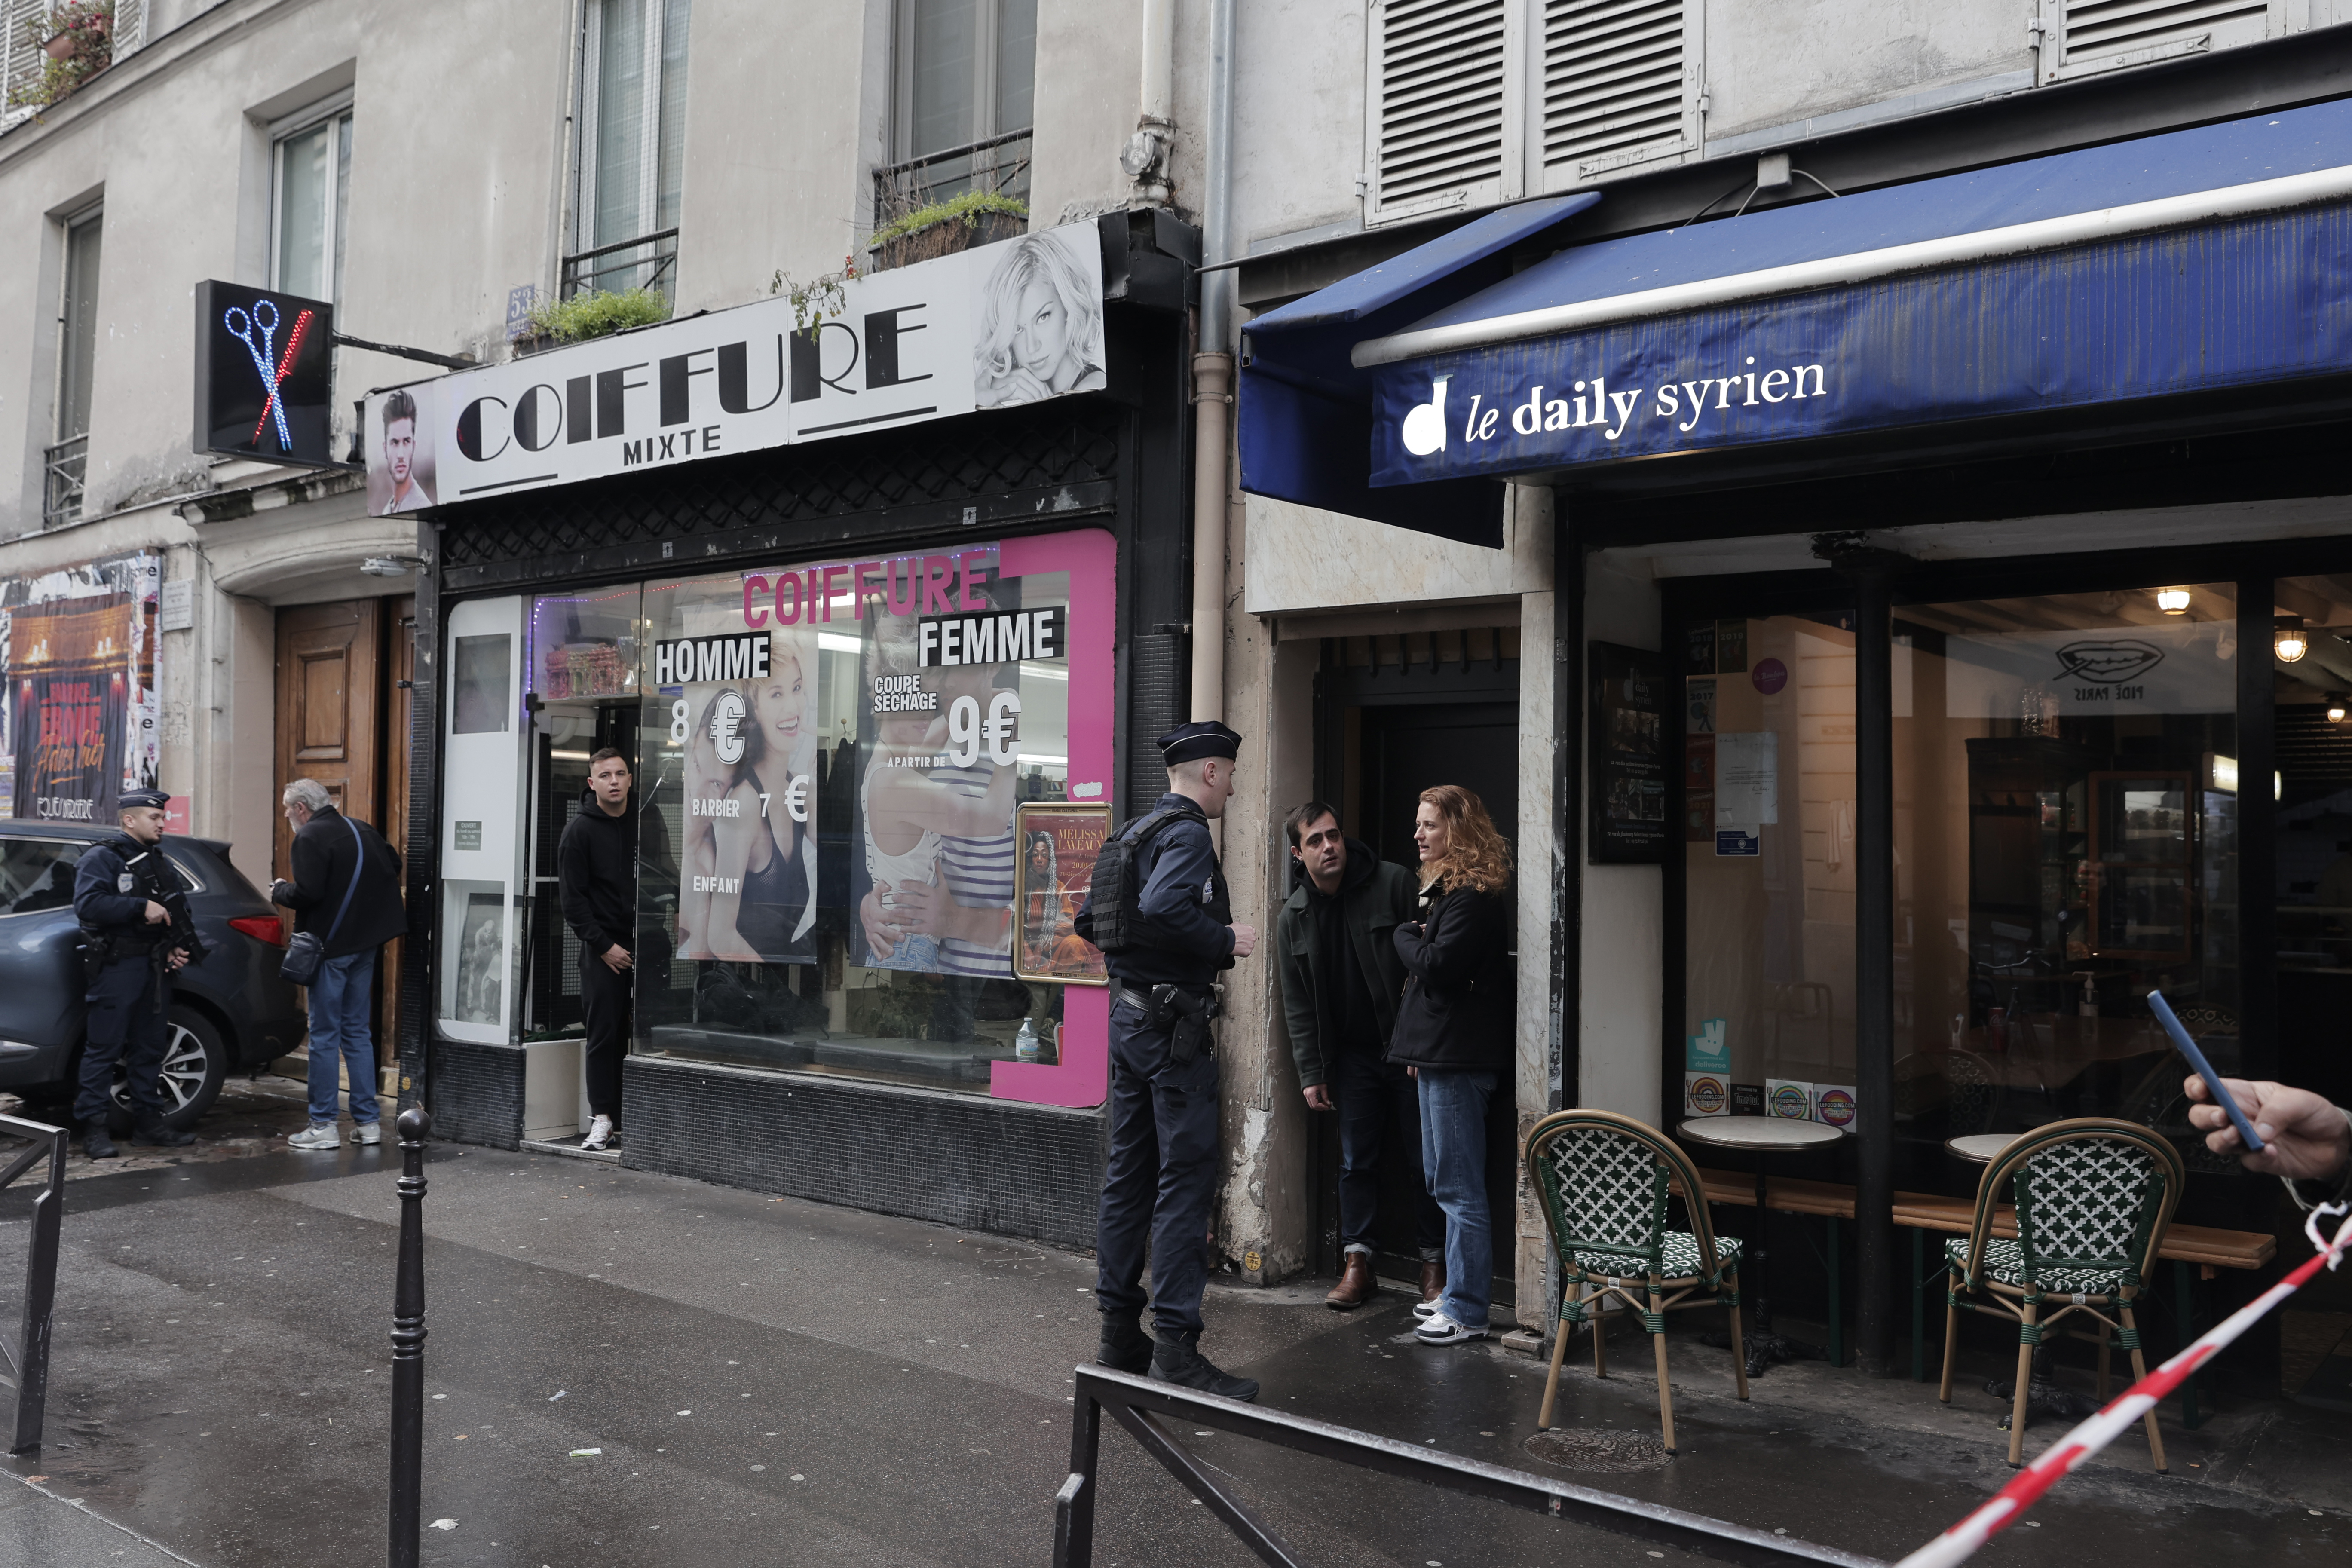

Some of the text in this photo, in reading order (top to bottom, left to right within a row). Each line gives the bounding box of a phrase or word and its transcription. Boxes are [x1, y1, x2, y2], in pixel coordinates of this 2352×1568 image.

[511, 287, 531, 318] 53
[457, 303, 934, 463] COIFFURE
[1466, 395, 1498, 443] le
[1512, 375, 1643, 441] daily
[1656, 356, 1828, 432] syrien
[623, 425, 721, 465] MIXTE
[743, 550, 987, 628] COIFFURE
[919, 610, 1054, 667] FEMME
[1689, 634, 1713, 643] 2018
[1694, 625, 1714, 634] Routard
[1720, 632, 1744, 640] 2019
[656, 636, 769, 683] HOMME
[874, 674, 921, 695] COUPE
[1635, 681, 1649, 697] daily
[873, 692, 937, 714] SECHAGE
[1635, 695, 1652, 707] syrien
[671, 699, 690, 744] 8
[895, 756, 931, 767] PARTIR
[933, 756, 945, 767] DE
[949, 692, 1021, 768] 9€
[692, 775, 810, 822] BARBIER 7 €
[1693, 792, 1712, 800] Routard
[1059, 826, 1104, 840] MÉLISSA
[1058, 839, 1104, 851] LAVEAUX
[693, 876, 739, 894] ENFANT
